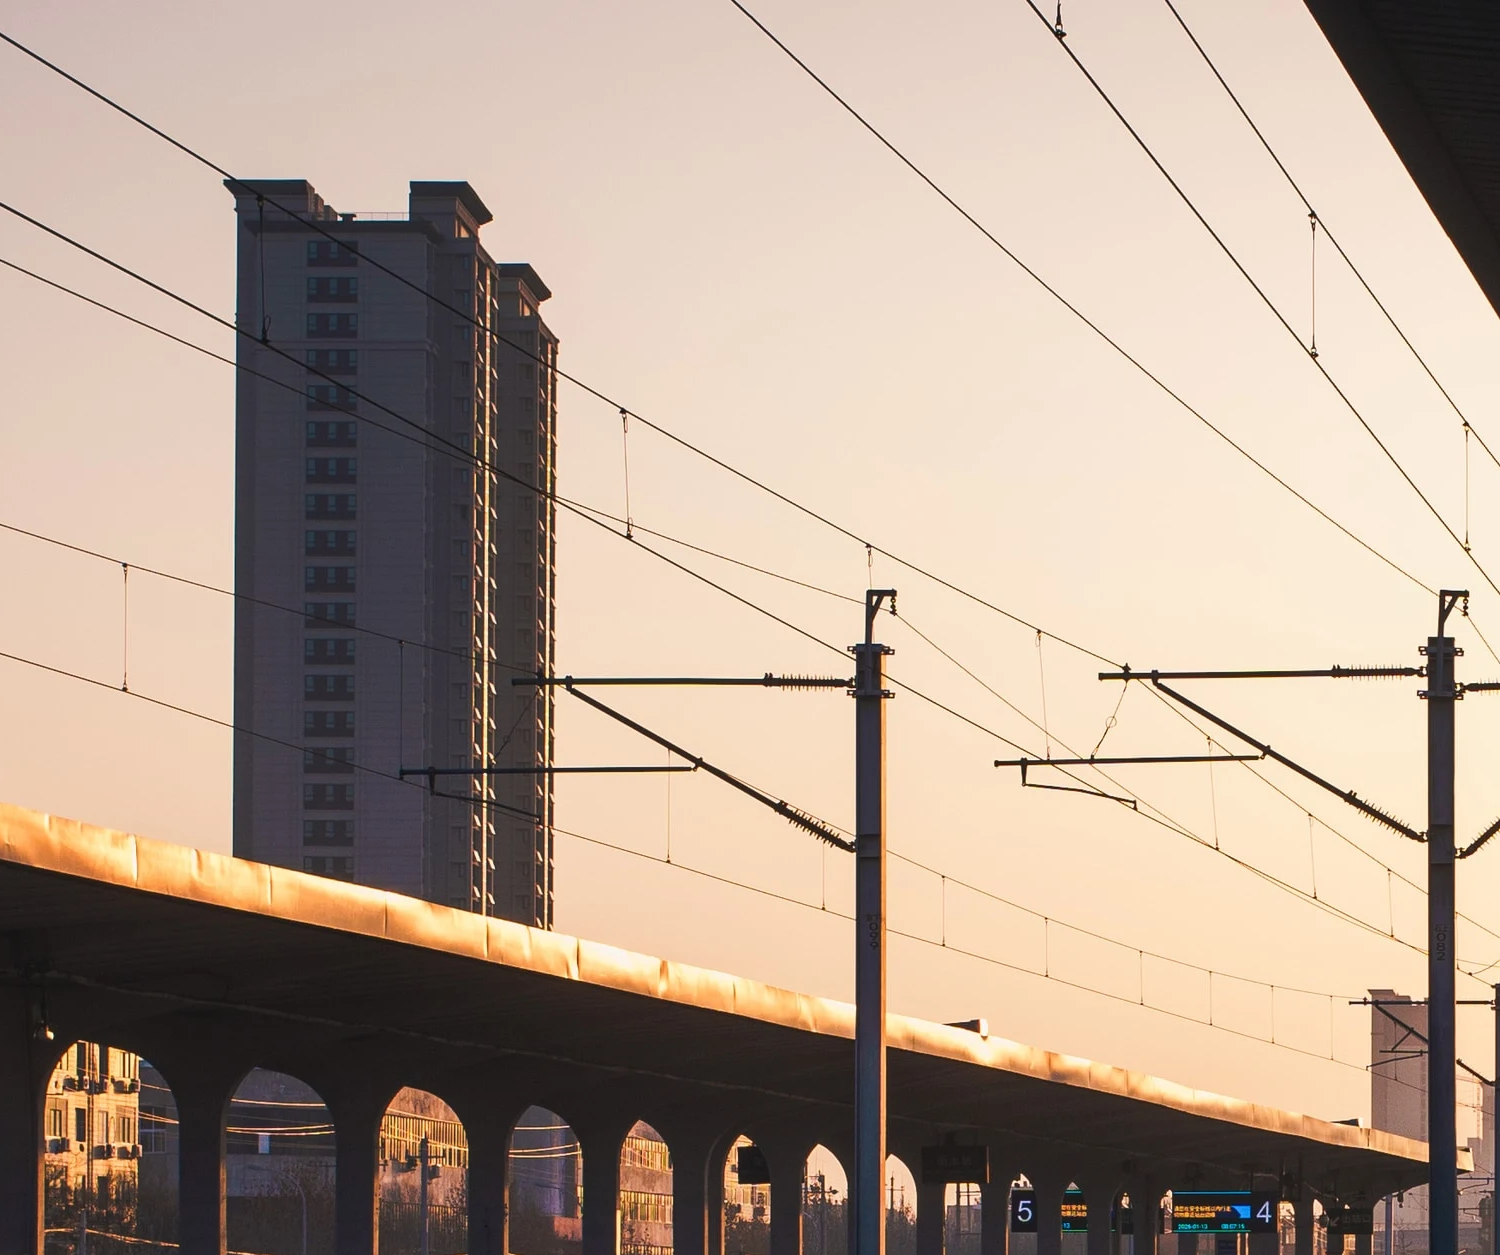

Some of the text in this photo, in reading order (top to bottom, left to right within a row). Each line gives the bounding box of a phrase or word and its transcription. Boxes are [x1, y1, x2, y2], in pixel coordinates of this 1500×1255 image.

[1436, 932, 1446, 961] 082
[1017, 1200, 1033, 1223] 5
[1256, 1200, 1272, 1223] 4
